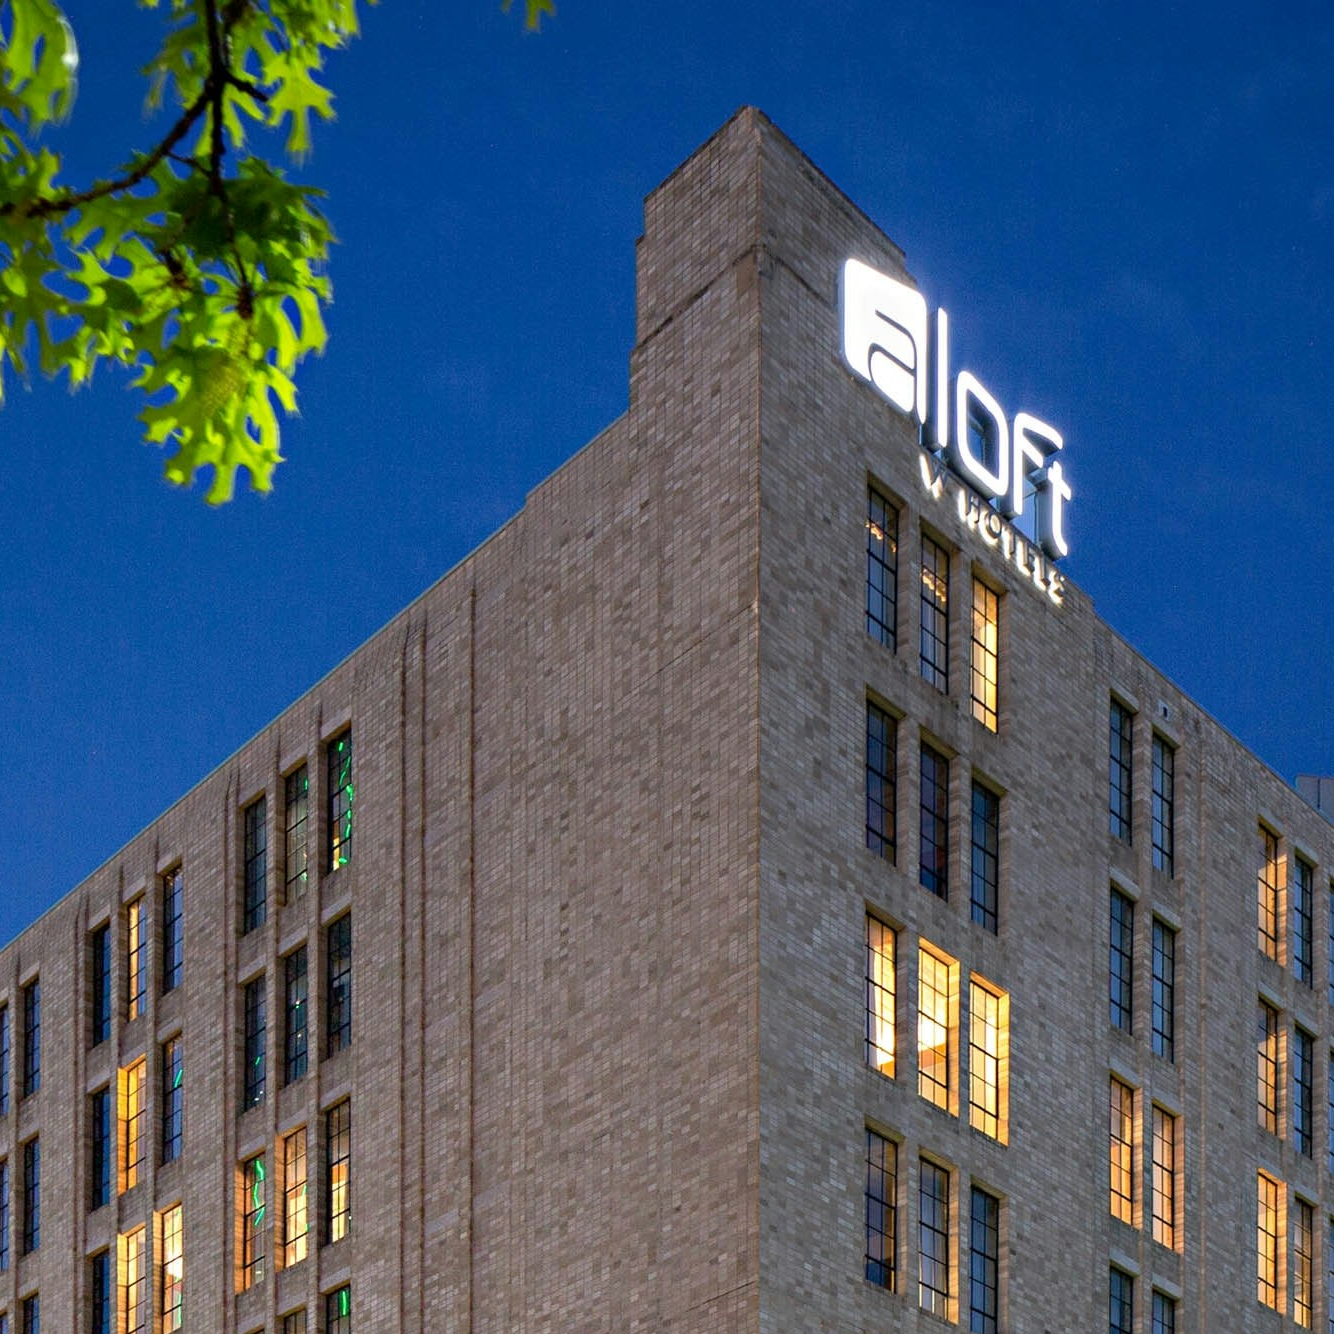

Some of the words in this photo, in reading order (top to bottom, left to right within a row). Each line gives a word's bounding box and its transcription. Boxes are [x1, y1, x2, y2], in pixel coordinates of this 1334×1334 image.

[843, 257, 1071, 557] aloft
[920, 453, 946, 499] W
[957, 488, 1065, 604] HOTELS
